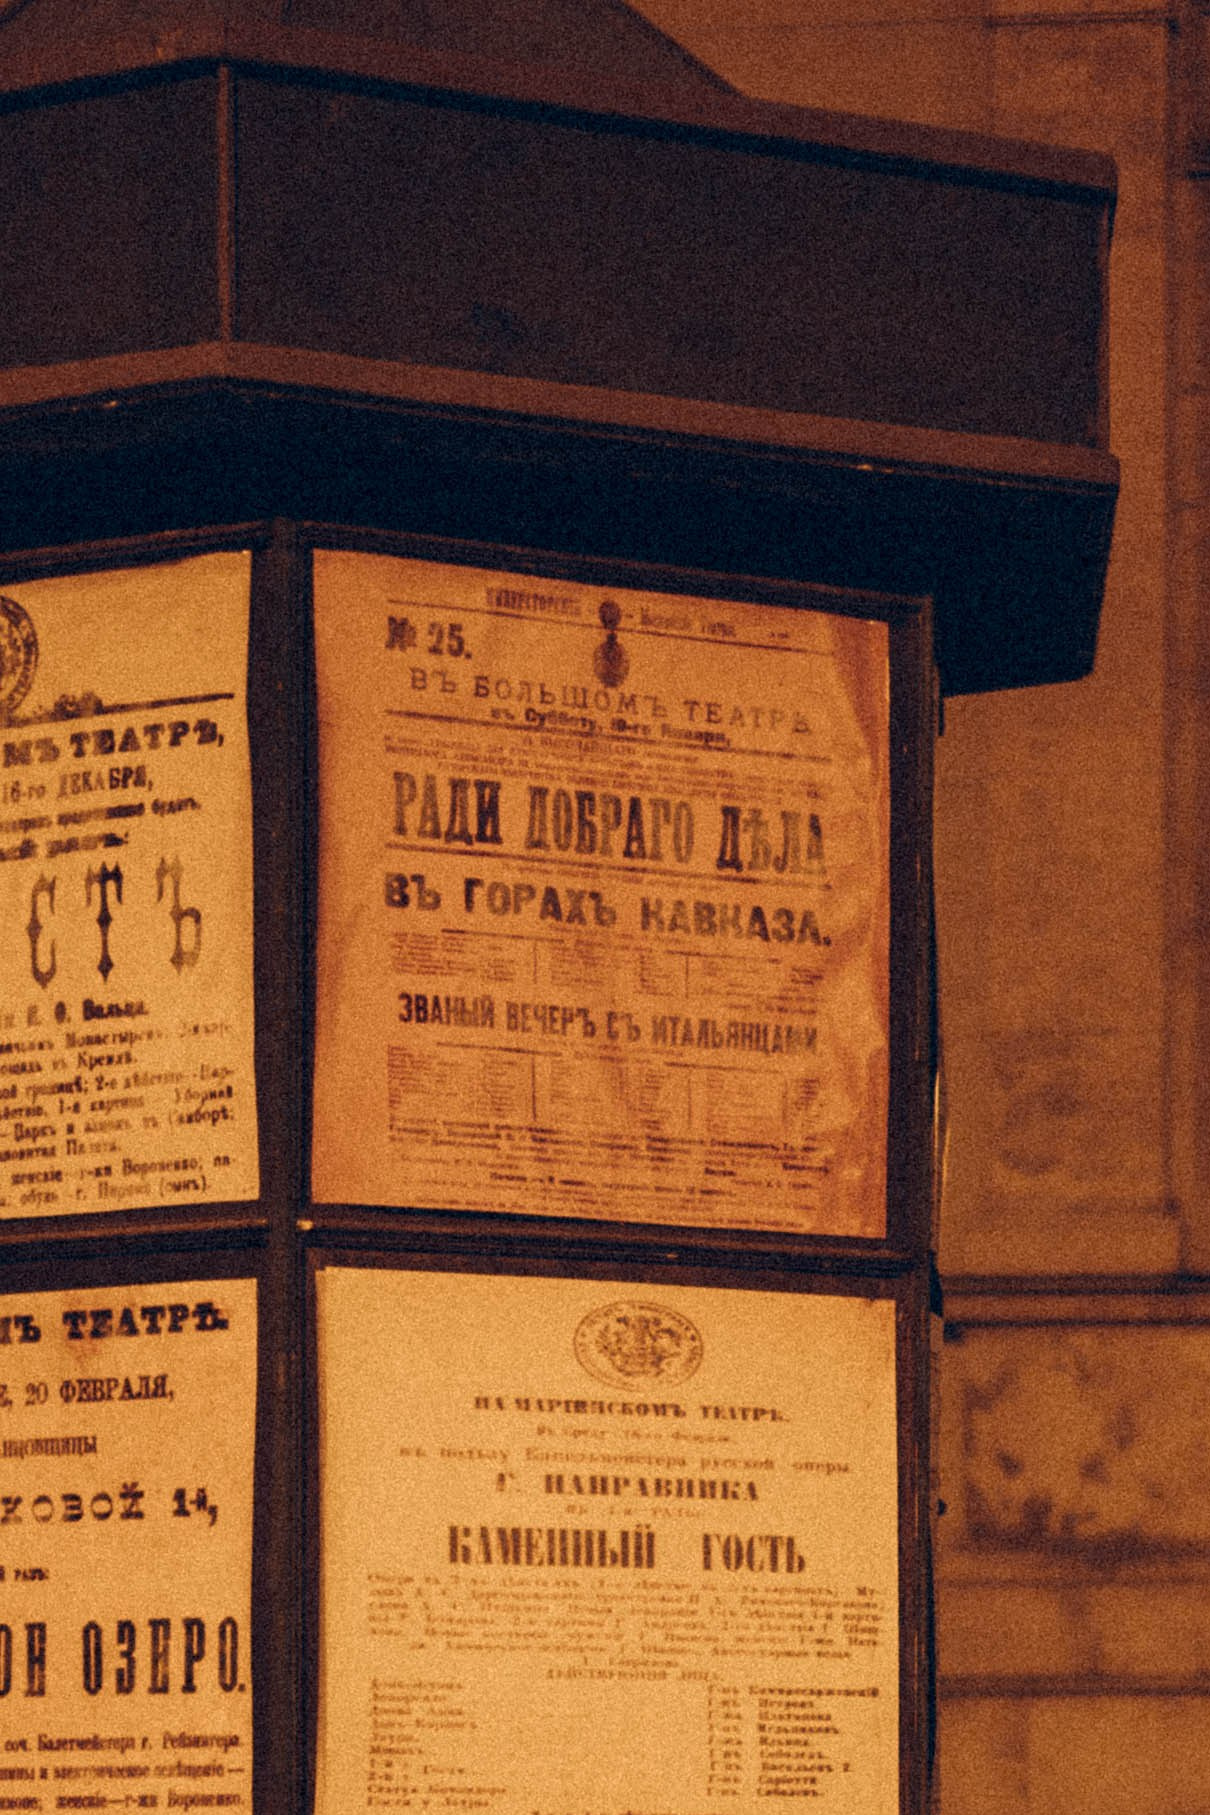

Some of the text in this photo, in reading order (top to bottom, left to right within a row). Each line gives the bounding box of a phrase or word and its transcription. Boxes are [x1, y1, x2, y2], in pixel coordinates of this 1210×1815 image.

[409, 667, 457, 694] ВЪ
[392, 771, 503, 845] РАДИ
[524, 783, 697, 864] ДОБРАГО
[383, 872, 442, 911] ВЪ
[464, 876, 618, 928] ГОРАХЪ
[398, 992, 496, 1029] ЗВАНЫЙ
[505, 1002, 597, 1039] ВЕЧЕРЪ
[606, 1009, 642, 1042] СЪ
[25, 1382, 48, 1406] 20
[447, 1524, 807, 1575] КАМЕННЫЙ ГОСТЬ
